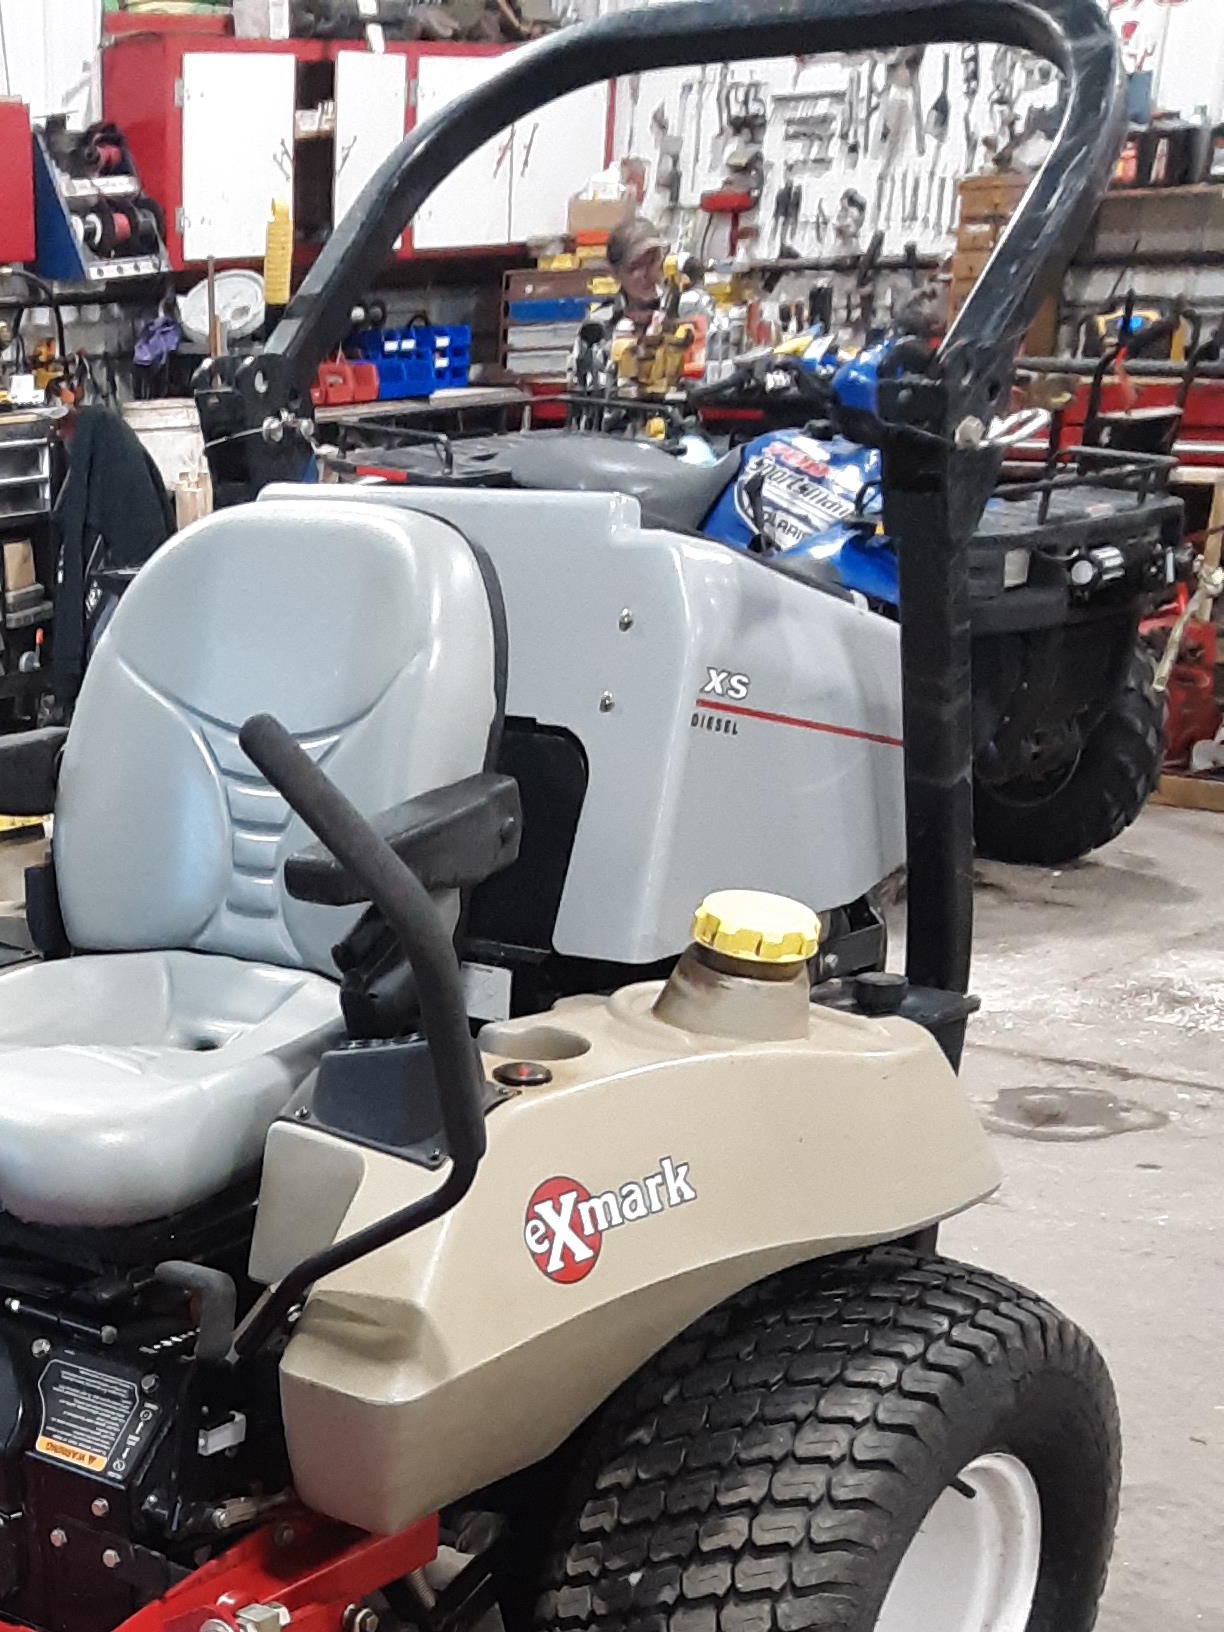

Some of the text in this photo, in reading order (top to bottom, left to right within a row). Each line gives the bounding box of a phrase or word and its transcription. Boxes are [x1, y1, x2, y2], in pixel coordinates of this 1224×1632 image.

[701, 667, 750, 700] XS
[690, 713, 738, 735] DIESEL
[45, 1441, 86, 1463] WARNING
